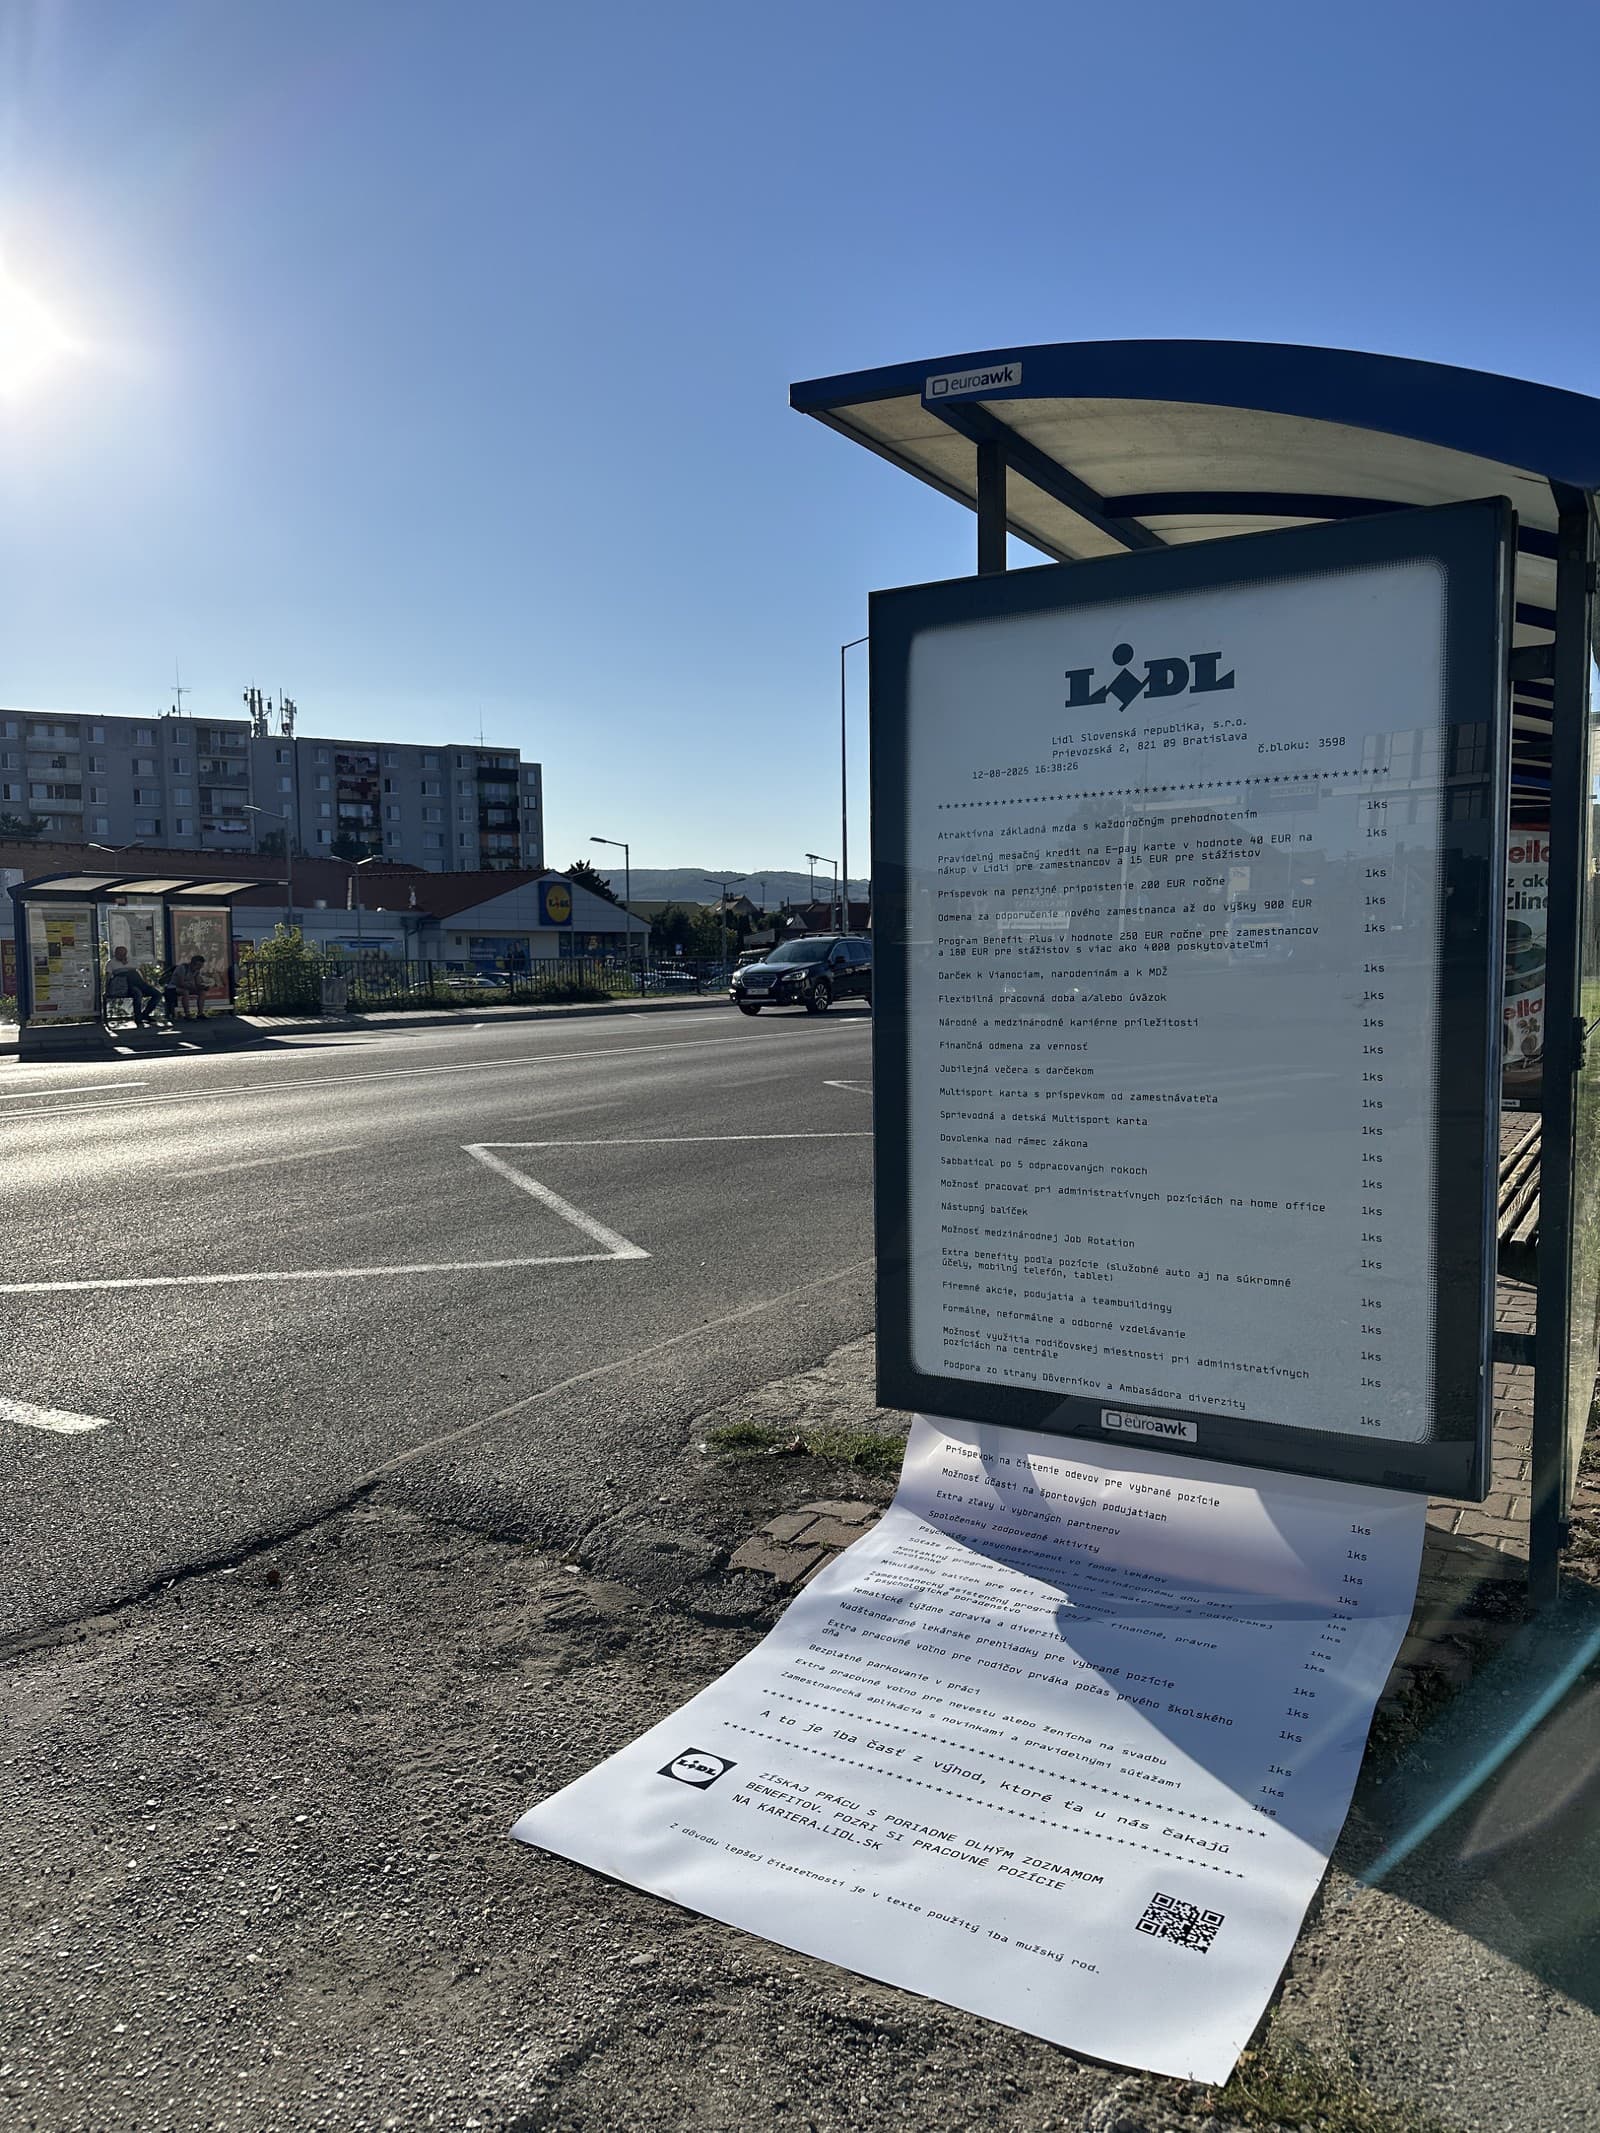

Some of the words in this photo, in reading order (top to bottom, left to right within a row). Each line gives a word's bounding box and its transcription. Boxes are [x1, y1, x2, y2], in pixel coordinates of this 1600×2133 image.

[950, 367, 1015, 393] euroawk
[1051, 733, 1074, 745] Lidl
[1080, 726, 1137, 742] Slovenská
[1142, 721, 1205, 737] republika,
[1317, 735, 1346, 748] 3598
[1051, 743, 1112, 759] Prievozská
[1136, 739, 1157, 751] 821
[1162, 737, 1176, 748] 09
[1182, 731, 1248, 746] Bratislava
[971, 765, 1029, 780] 12-08-2025
[1034, 760, 1079, 774] 16:38:26
[1365, 799, 1388, 810] 1ks
[937, 828, 994, 840] Atraktívna
[999, 823, 1046, 836] základná
[1051, 822, 1076, 833] mzda
[937, 993, 993, 1003] Flexibilná
[998, 992, 1045, 1004] pracovná
[1050, 993, 1075, 1002] doba
[1080, 992, 1123, 1002] a/alebo
[938, 1017, 977, 1027] Národné
[1069, 1016, 1118, 1027] kariérne
[1361, 1017, 1384, 1028] 1ks
[938, 1040, 983, 1050] Finančná
[987, 1041, 1024, 1050] odmena
[1028, 1042, 1041, 1050] za
[1046, 1040, 1088, 1051] vernosť
[938, 1063, 989, 1074] Jubilejná
[993, 1063, 1029, 1074] večera
[1045, 1064, 1094, 1076] darčekom
[939, 1109, 994, 1120] Sprievodná
[1011, 1112, 1046, 1122] detská
[1051, 1113, 1110, 1126] Multisport
[1115, 1115, 1148, 1126] karta
[939, 1132, 989, 1143] Dovolenka
[994, 1135, 1012, 1144] nad
[1017, 1135, 1047, 1146] rámec
[1051, 1137, 1088, 1148] zákona
[939, 1178, 979, 1189] Možnosť
[983, 1182, 1029, 1192] pracovať
[1033, 1184, 1051, 1194] pri
[1166, 1192, 1223, 1205] pozíciách
[1229, 1197, 1243, 1206] na
[1249, 1197, 1278, 1209] home
[1284, 1200, 1326, 1212] office
[940, 1200, 985, 1215] Nástupný
[989, 1204, 1028, 1216] balíček
[1360, 1205, 1383, 1216] 1ks
[940, 1223, 979, 1236] Možnosť
[1063, 1233, 1082, 1244] Job
[1086, 1235, 1135, 1248] Rotation
[1359, 1350, 1382, 1362] 1ks
[1124, 1415, 1189, 1438] euroawk
[945, 1444, 995, 1462] Príspevok
[1016, 1458, 1060, 1476] čistenie
[1064, 1469, 1100, 1484] odevov
[1104, 1478, 1123, 1489] pre
[1129, 1483, 1172, 1500] vybrané
[1177, 1491, 1220, 1508] pozície
[942, 1467, 981, 1484] Možnosť
[984, 1475, 1018, 1491] účasti
[1022, 1485, 1035, 1495] na
[1039, 1487, 1098, 1508] športových
[936, 1490, 964, 1503] Extra
[967, 1496, 995, 1512] zľavy
[1011, 1505, 1062, 1524] vybraných
[1067, 1519, 1121, 1536] partnerov
[991, 1523, 1049, 1542] zodpovedné
[1053, 1536, 1101, 1554] aktivity
[1350, 1524, 1372, 1536] 1ks
[1347, 1550, 1368, 1562] 1ks
[922, 1622, 972, 1640] lekárske
[976, 1635, 1039, 1658] prehliadky
[1044, 1652, 1066, 1665] pre
[1072, 1657, 1121, 1676] vybrané
[1126, 1670, 1175, 1689] pozície
[827, 1619, 857, 1633] Extra
[861, 1629, 911, 1648] pracovné
[916, 1639, 947, 1656] voľno
[951, 1651, 972, 1663] pre
[977, 1657, 1023, 1675] rodičov
[1028, 1670, 1069, 1688] prváka
[1074, 1680, 1110, 1698] počas
[1116, 1692, 1160, 1710] prvého
[1167, 1703, 1234, 1727] školského
[1286, 1707, 1310, 1720] 1ks
[1279, 1730, 1303, 1743] 1ks
[778, 1714, 797, 1726] to
[802, 1721, 823, 1734] je
[832, 1729, 858, 1744] iba
[866, 1739, 906, 1758] časť
[933, 1759, 987, 1785] výhod,
[999, 1780, 1054, 1804] ktoré
[1063, 1798, 1084, 1813] ťa
[1116, 1815, 1150, 1831] nás
[1161, 1825, 1231, 1855] čakajú
[732, 1794, 751, 1806] NA
[745, 1781, 825, 1814] BENEFITOV.
[833, 1811, 880, 1833] POZRI
[886, 1830, 905, 1842] SI
[912, 1839, 991, 1867] PRACOVNÉ
[998, 1864, 1066, 1890] POZÍCIE
[758, 1771, 810, 1793] ZÍSKAJ
[815, 1789, 861, 1811] PRÁCU
[884, 1813, 958, 1842] PORIADNE
[964, 1838, 1016, 1859] DLHÝM
[1021, 1856, 1105, 1885] ZOZNAMOM
[682, 1825, 719, 1846] dôvodu
[724, 1842, 763, 1863] lepšej
[849, 1884, 866, 1894] je
[886, 1895, 922, 1913] texte
[926, 1910, 980, 1934] použitý
[987, 1929, 1009, 1943] iba
[1015, 1939, 1065, 1963] mužský
[1071, 1957, 1101, 1974] rod.
